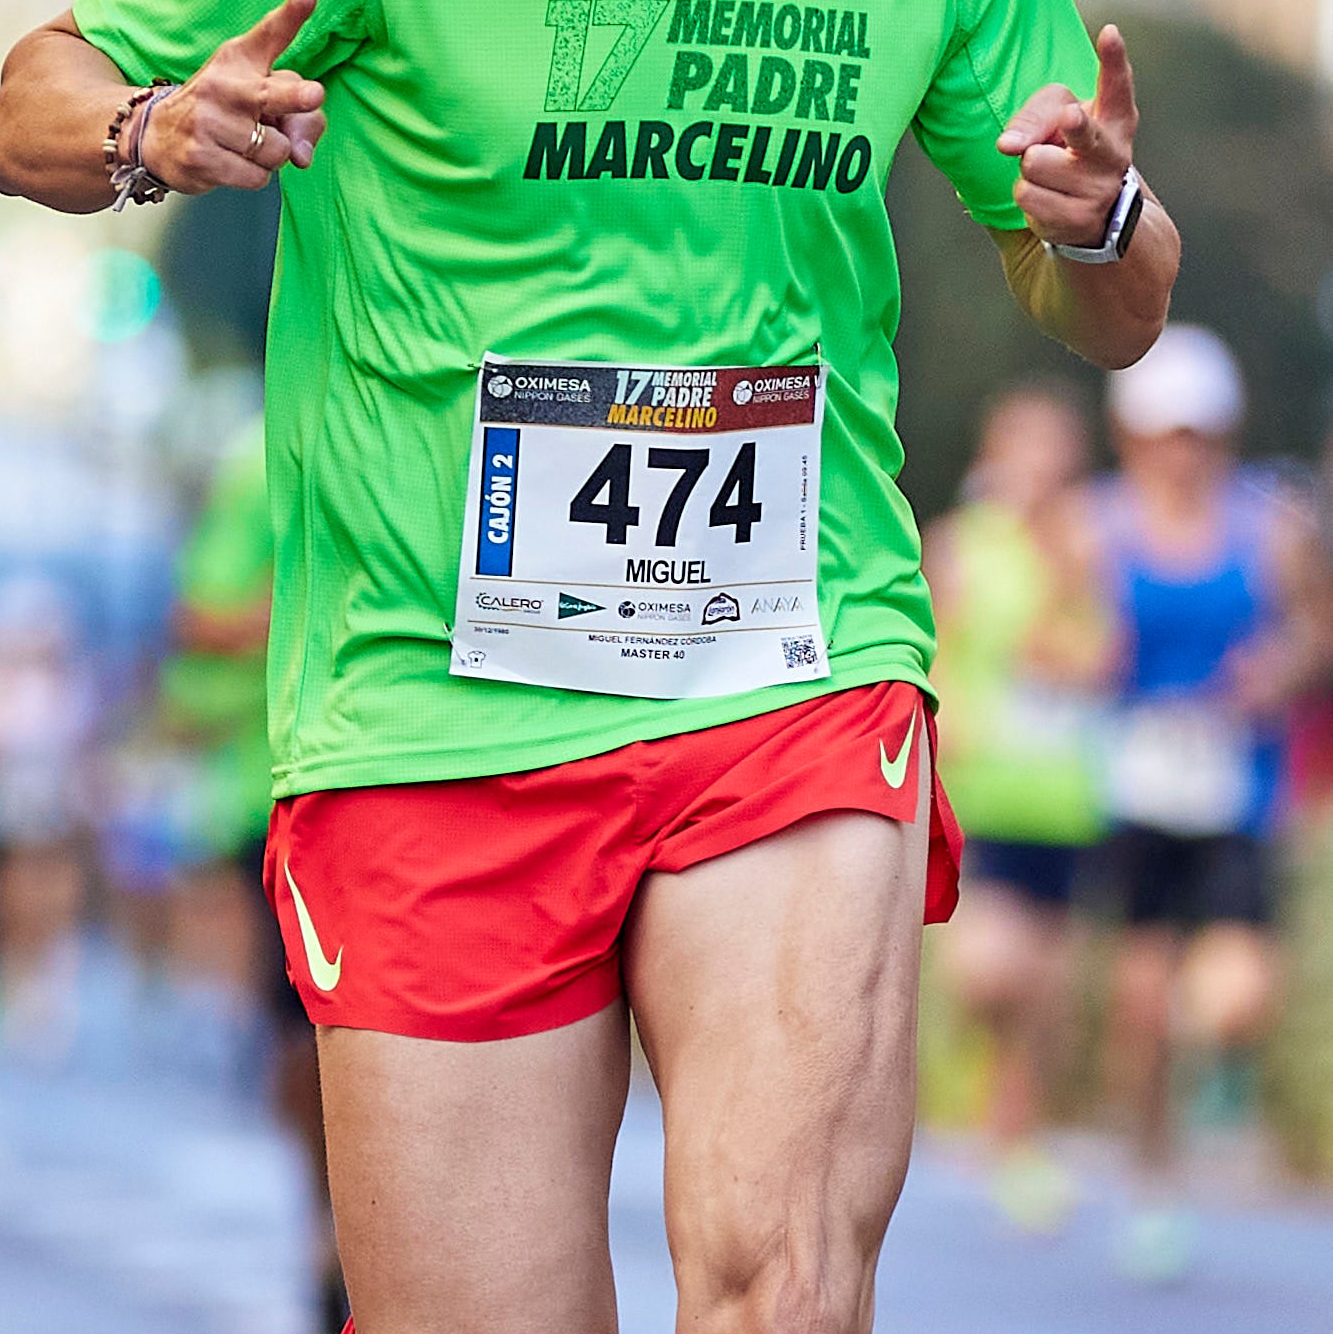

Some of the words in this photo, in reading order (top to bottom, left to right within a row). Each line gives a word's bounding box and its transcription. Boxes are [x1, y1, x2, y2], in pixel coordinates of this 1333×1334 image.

[666, 50, 863, 124] PADRE
[522, 120, 873, 196] MARCELINO
[514, 376, 591, 392] OXIMESA
[615, 370, 653, 405] 17
[651, 371, 717, 387] MEMORIAL
[754, 376, 811, 391] OXIMESA
[514, 391, 553, 402] NIPPON
[556, 393, 592, 404] GASES
[651, 387, 712, 407] PADRE
[752, 394, 783, 404] NIPPON
[783, 391, 810, 400] GASES
[607, 405, 717, 428] MARCELINO
[492, 454, 513, 469] 2
[568, 442, 763, 548] 474
[485, 476, 511, 544] CAJÓN
[625, 559, 711, 584] MIGUEL
[481, 596, 542, 609] CALERO
[638, 602, 691, 613] OXIMESA
[751, 596, 804, 613] ANAYA
[588, 634, 623, 644] MIGUEL
[621, 648, 670, 660] MASTER
[673, 650, 685, 659] 40
